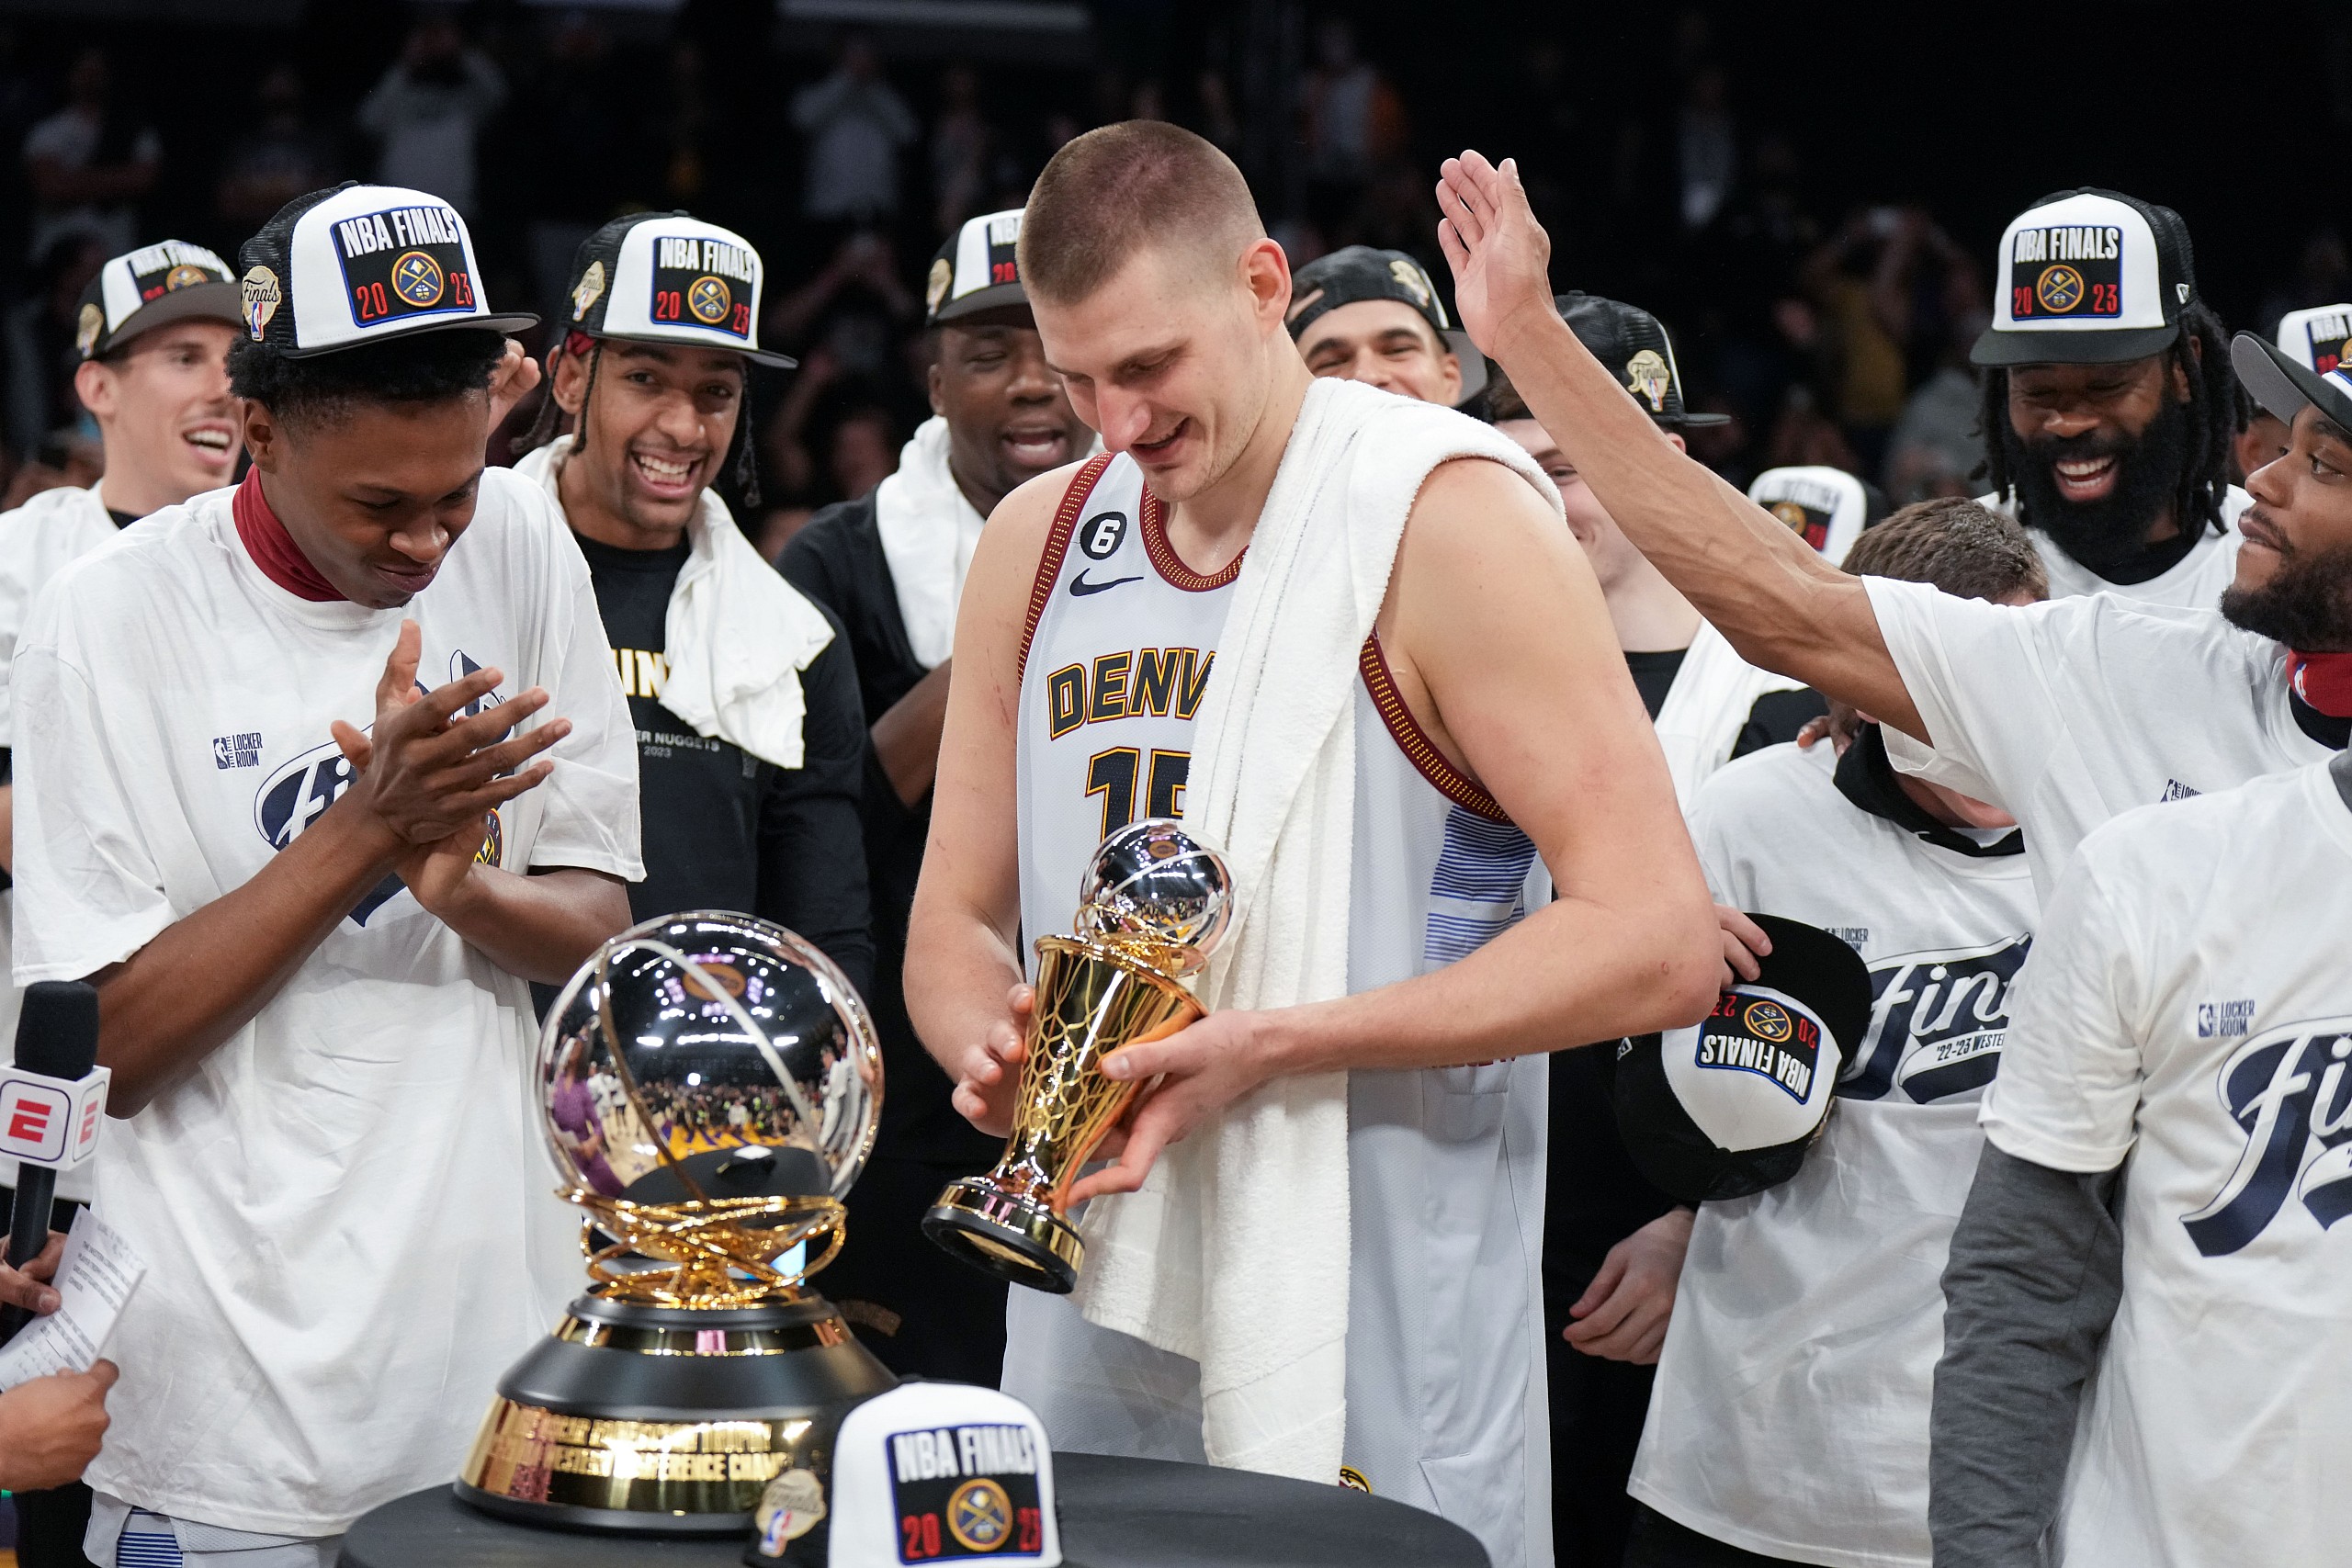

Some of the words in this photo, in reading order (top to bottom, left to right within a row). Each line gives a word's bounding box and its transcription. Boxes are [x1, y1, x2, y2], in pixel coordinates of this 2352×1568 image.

[339, 213, 393, 258] NBA
[390, 208, 459, 248] FINALS
[2015, 230, 2047, 264] NBA
[2050, 227, 2119, 261] FINALS
[660, 238, 700, 270] NBA
[703, 240, 754, 284] FINALS
[242, 278, 280, 303] Finals
[356, 282, 388, 320] 20
[450, 272, 473, 306] 23
[2013, 286, 2032, 315] 20
[2092, 284, 2118, 312] 23
[656, 291, 681, 320] 20
[732, 303, 750, 334] 23
[1091, 519, 1121, 554] 6
[1047, 647, 1216, 741] DENV
[232, 732, 263, 750] LOCKER
[643, 746, 673, 759] 2023
[655, 732, 720, 752] NUGGETS
[235, 750, 259, 768] ROOM
[2221, 999, 2255, 1018] LOCKER
[1797, 1018, 1819, 1049] 20
[2221, 1017, 2248, 1037] ROOM
[1701, 1034, 1775, 1074] FINALS
[1937, 1037, 1972, 1062] '22-'23
[1972, 1032, 2006, 1052] WESTE
[1776, 1049, 1811, 1098] NBA
[893, 1429, 959, 1483] NBA
[957, 1426, 1037, 1476] FINALS
[903, 1513, 942, 1559] 20
[1016, 1507, 1042, 1551] 23
